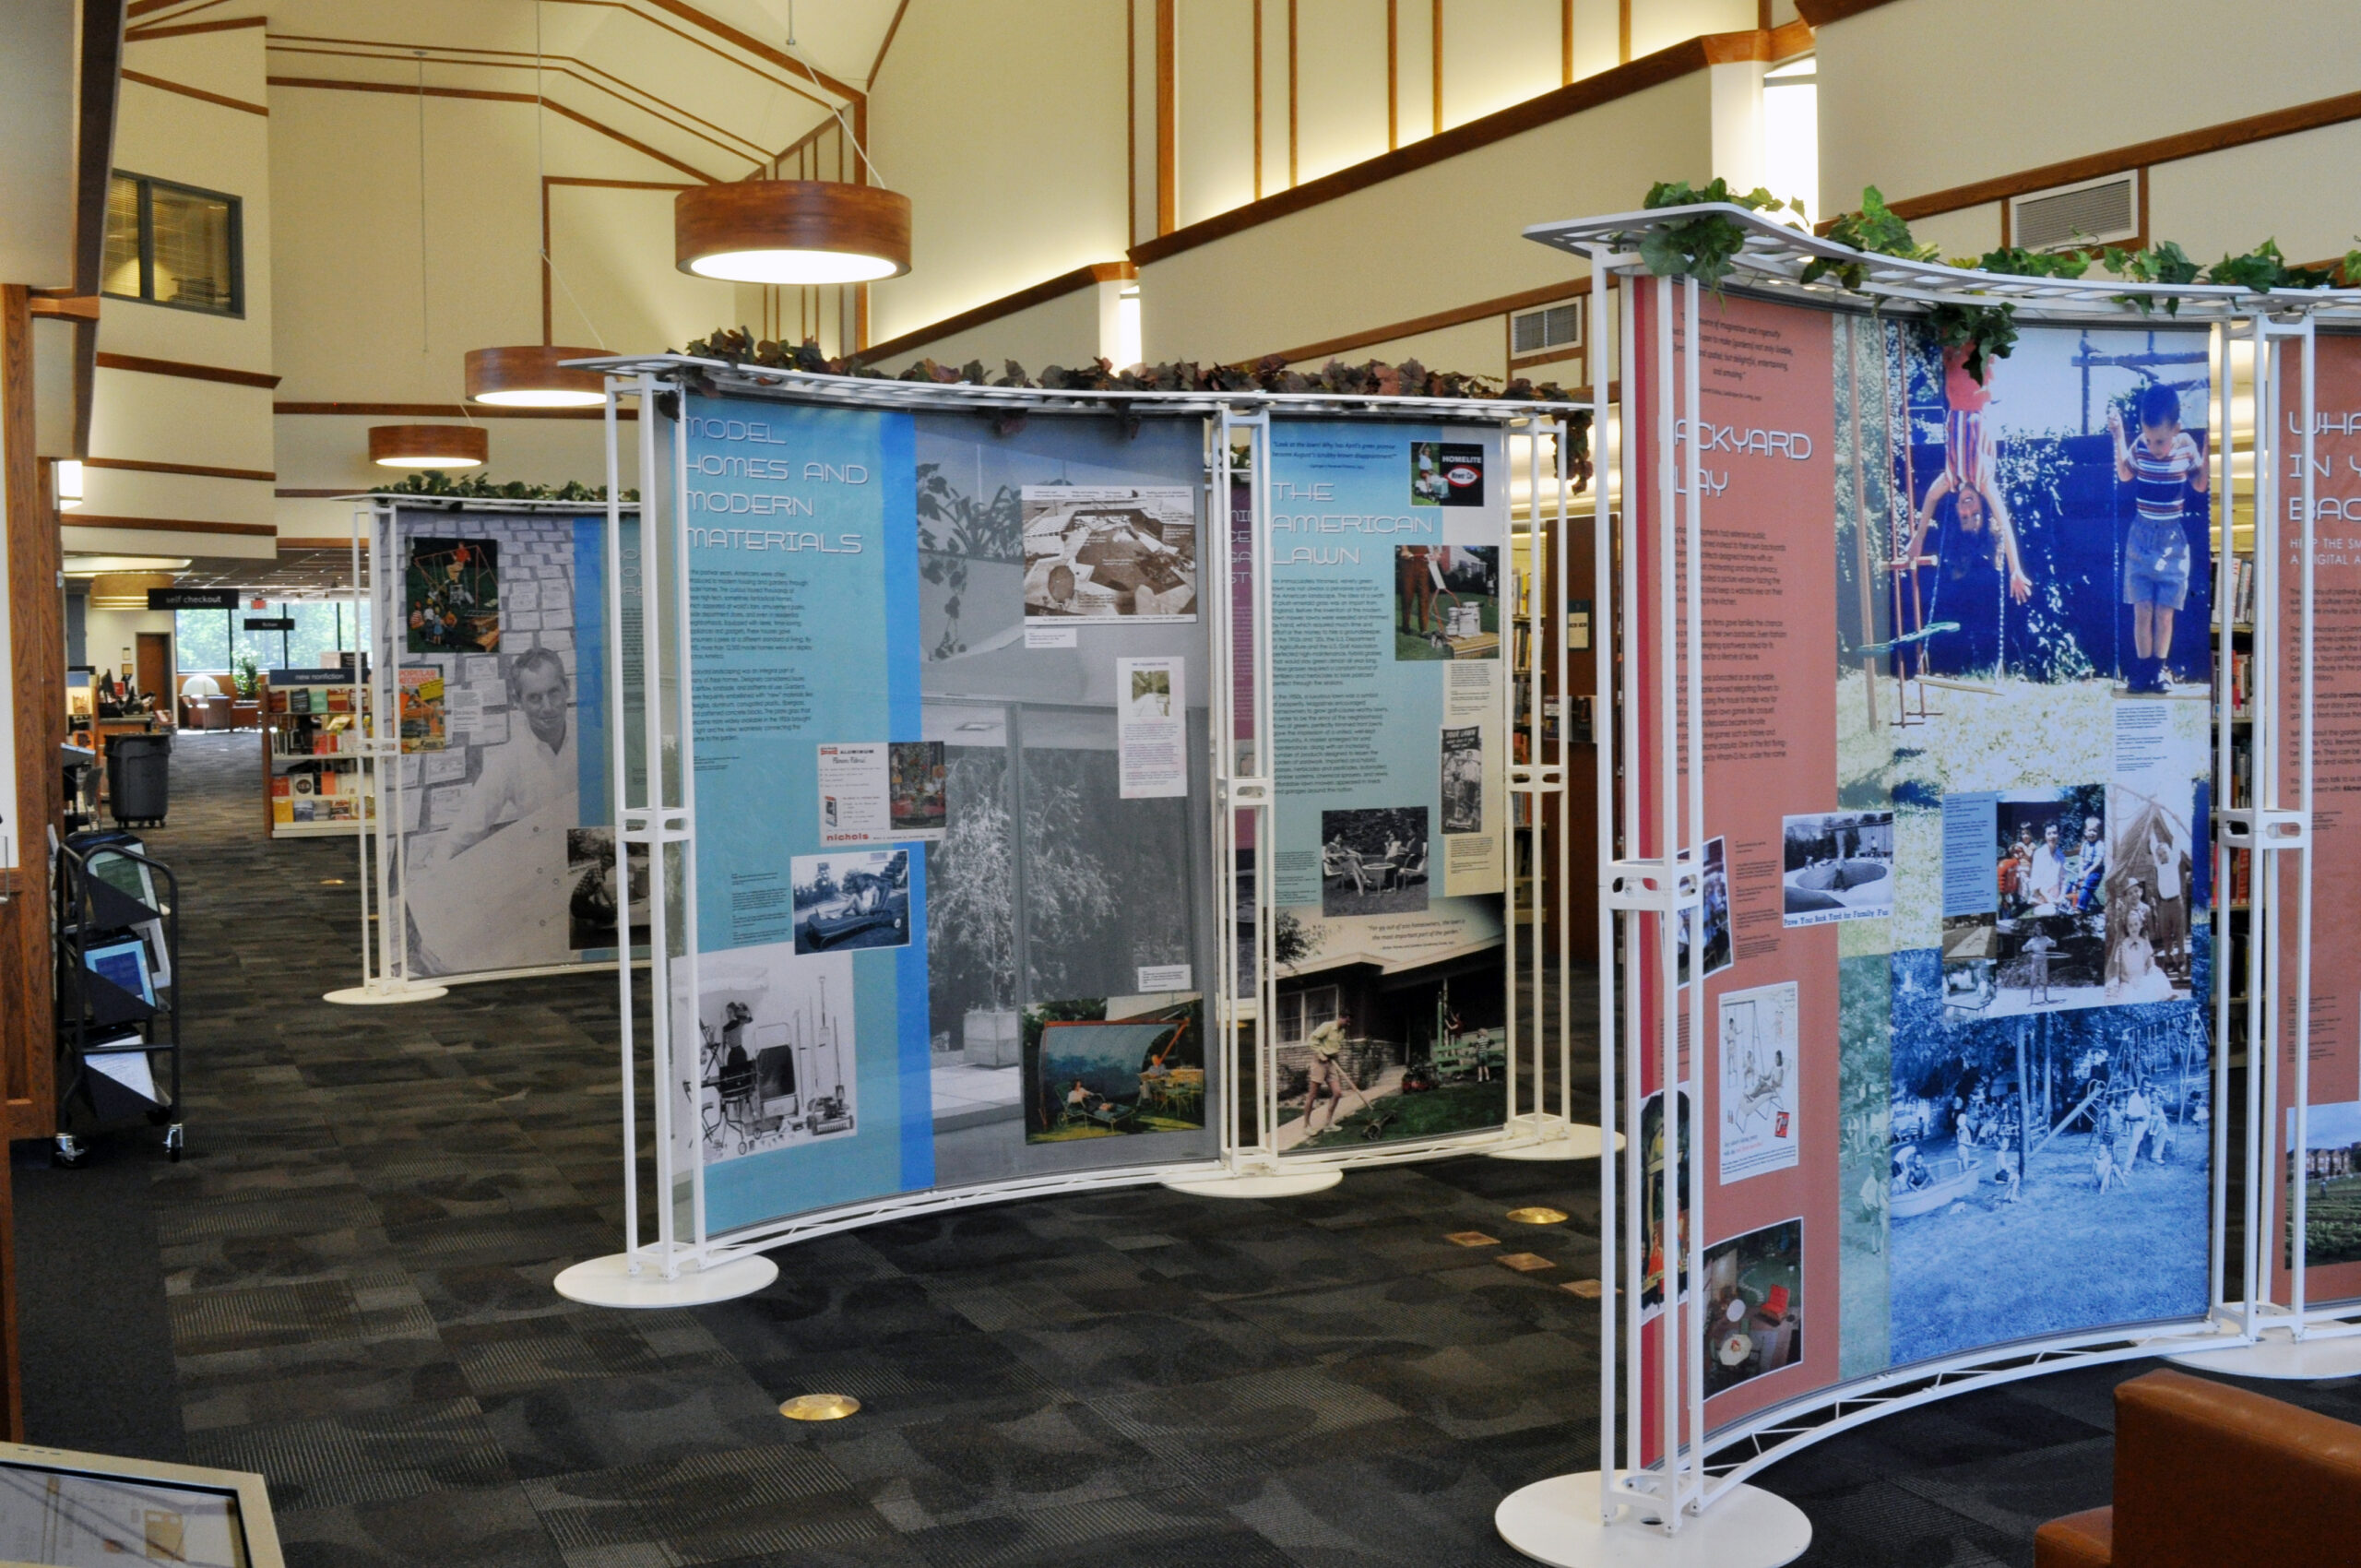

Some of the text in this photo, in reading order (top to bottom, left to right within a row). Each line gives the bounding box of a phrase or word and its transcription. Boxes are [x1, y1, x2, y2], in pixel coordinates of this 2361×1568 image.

[1659, 415, 1813, 460] ACKYARD
[1442, 455, 1482, 464] HOMELITE
[686, 454, 869, 485] HOMES AND
[1659, 465, 1729, 497] LAY
[1272, 481, 1335, 503] THE
[687, 491, 814, 517] MODERN
[1271, 514, 1433, 534] AMERICAN
[688, 528, 864, 554] MATERIALS
[2323, 538, 2343, 550] THE
[1271, 546, 1361, 565] LAWN
[2313, 554, 2347, 565] IGITAL
[184, 595, 221, 604] checkout
[312, 672, 345, 681] nonfiction
[826, 833, 870, 841] nichols
